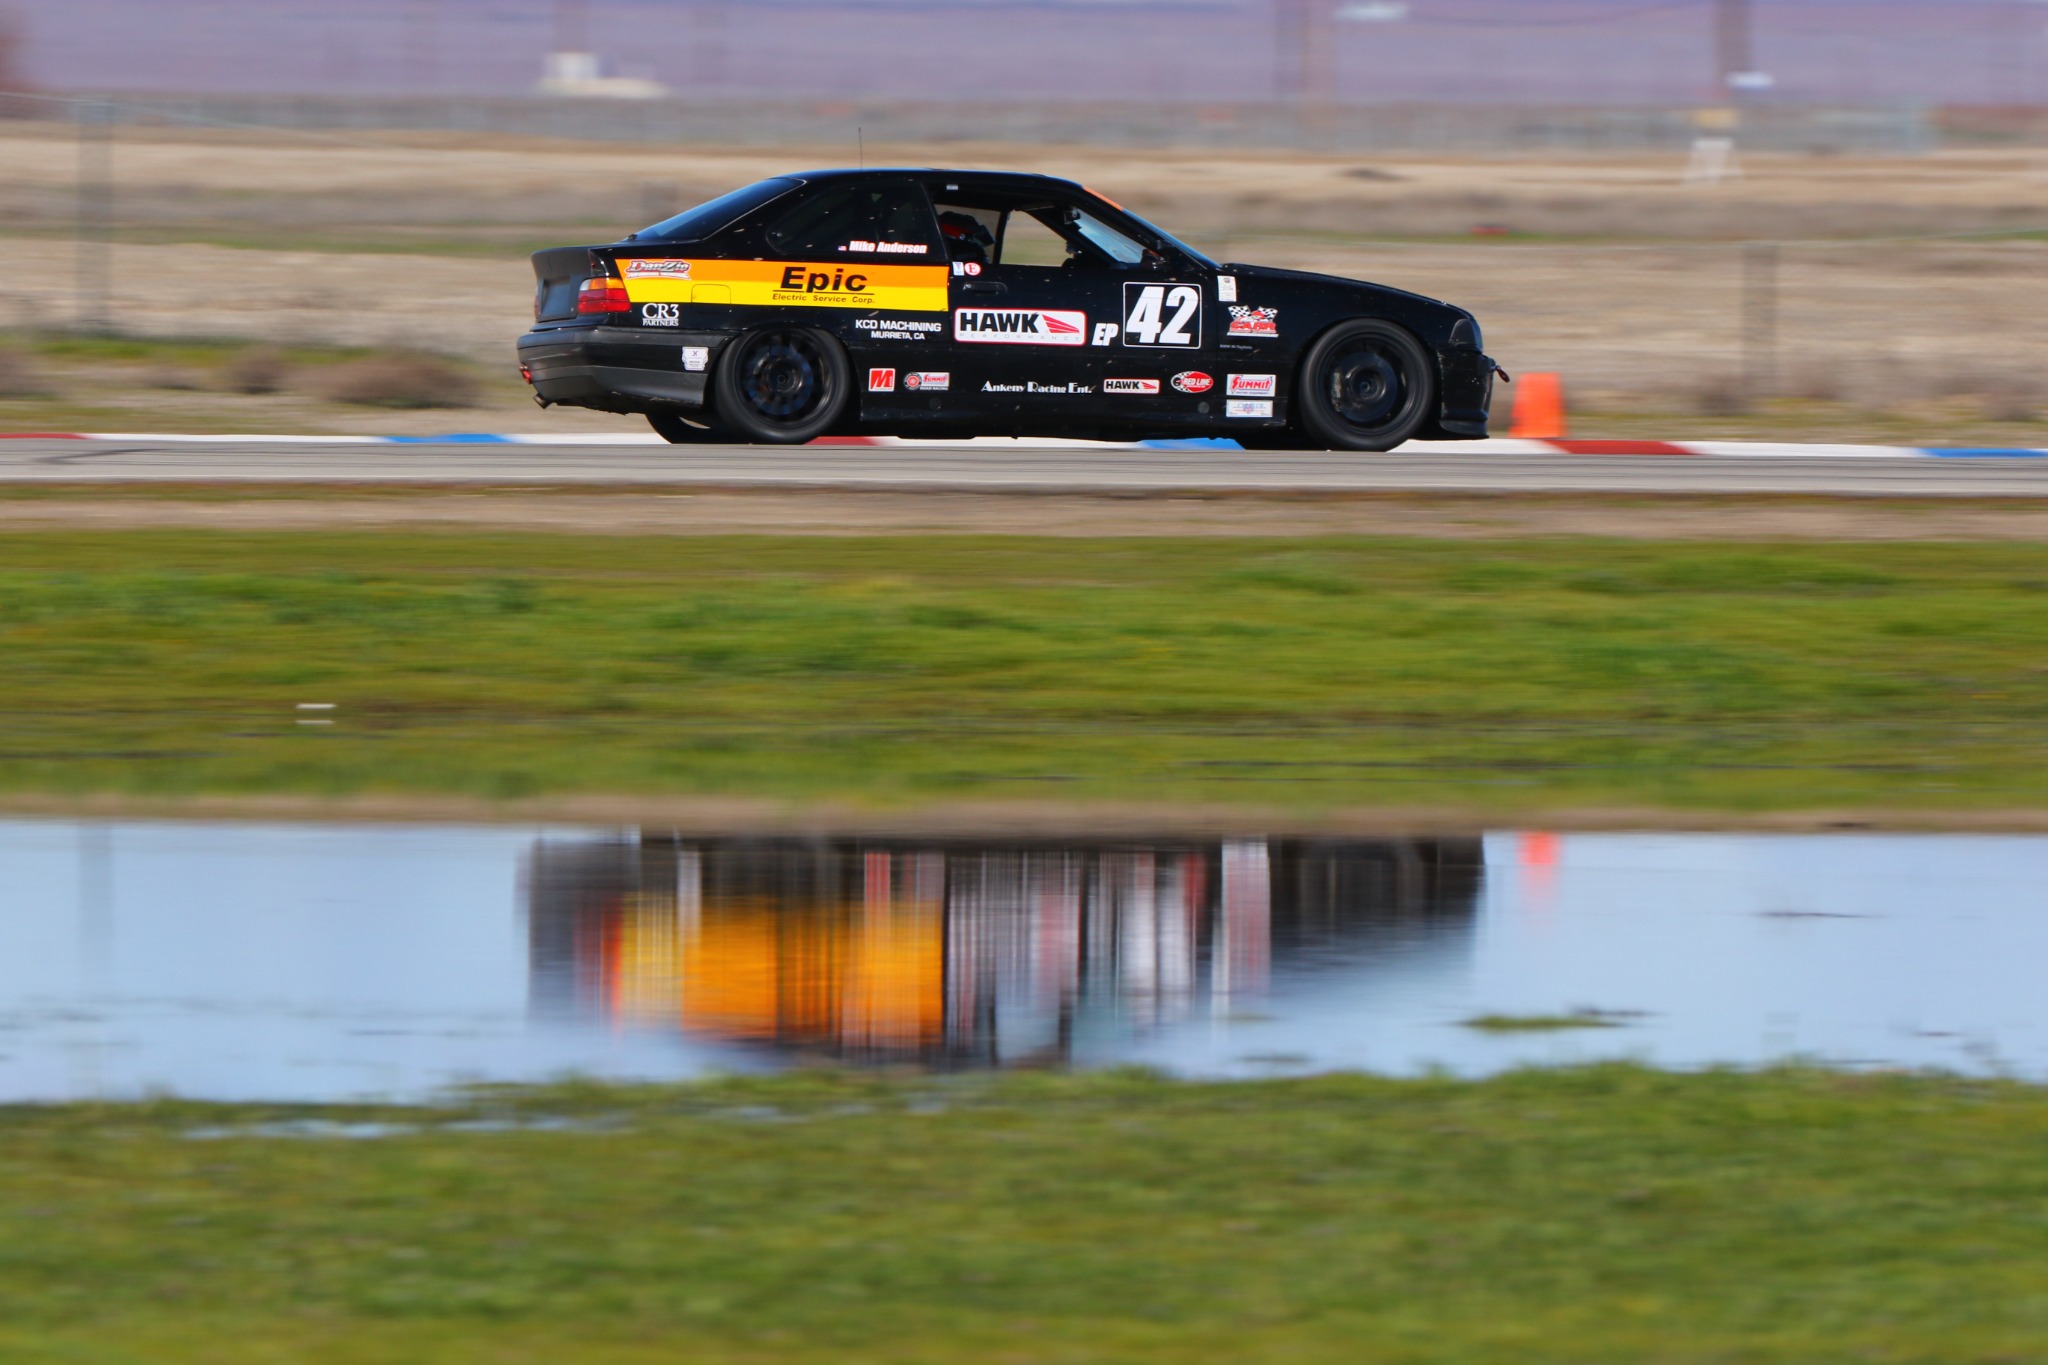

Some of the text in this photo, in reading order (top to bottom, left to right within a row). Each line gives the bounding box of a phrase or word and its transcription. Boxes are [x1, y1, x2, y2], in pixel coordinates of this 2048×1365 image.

[849, 241, 928, 254] Mike Anderson
[780, 266, 867, 293] Epic
[772, 293, 807, 301] Electric
[852, 296, 875, 304] Corp.
[642, 303, 679, 319] CR3
[1126, 286, 1199, 345] 42
[643, 319, 679, 327] PARTNERS
[855, 319, 942, 332] KCD MACHINING
[960, 312, 1039, 333] HAWK
[871, 331, 913, 340] MURRIETA,
[1092, 323, 1119, 346] EP
[981, 381, 1093, 394] Ankeny Racing Ent.
[1106, 380, 1140, 390] HAWK
